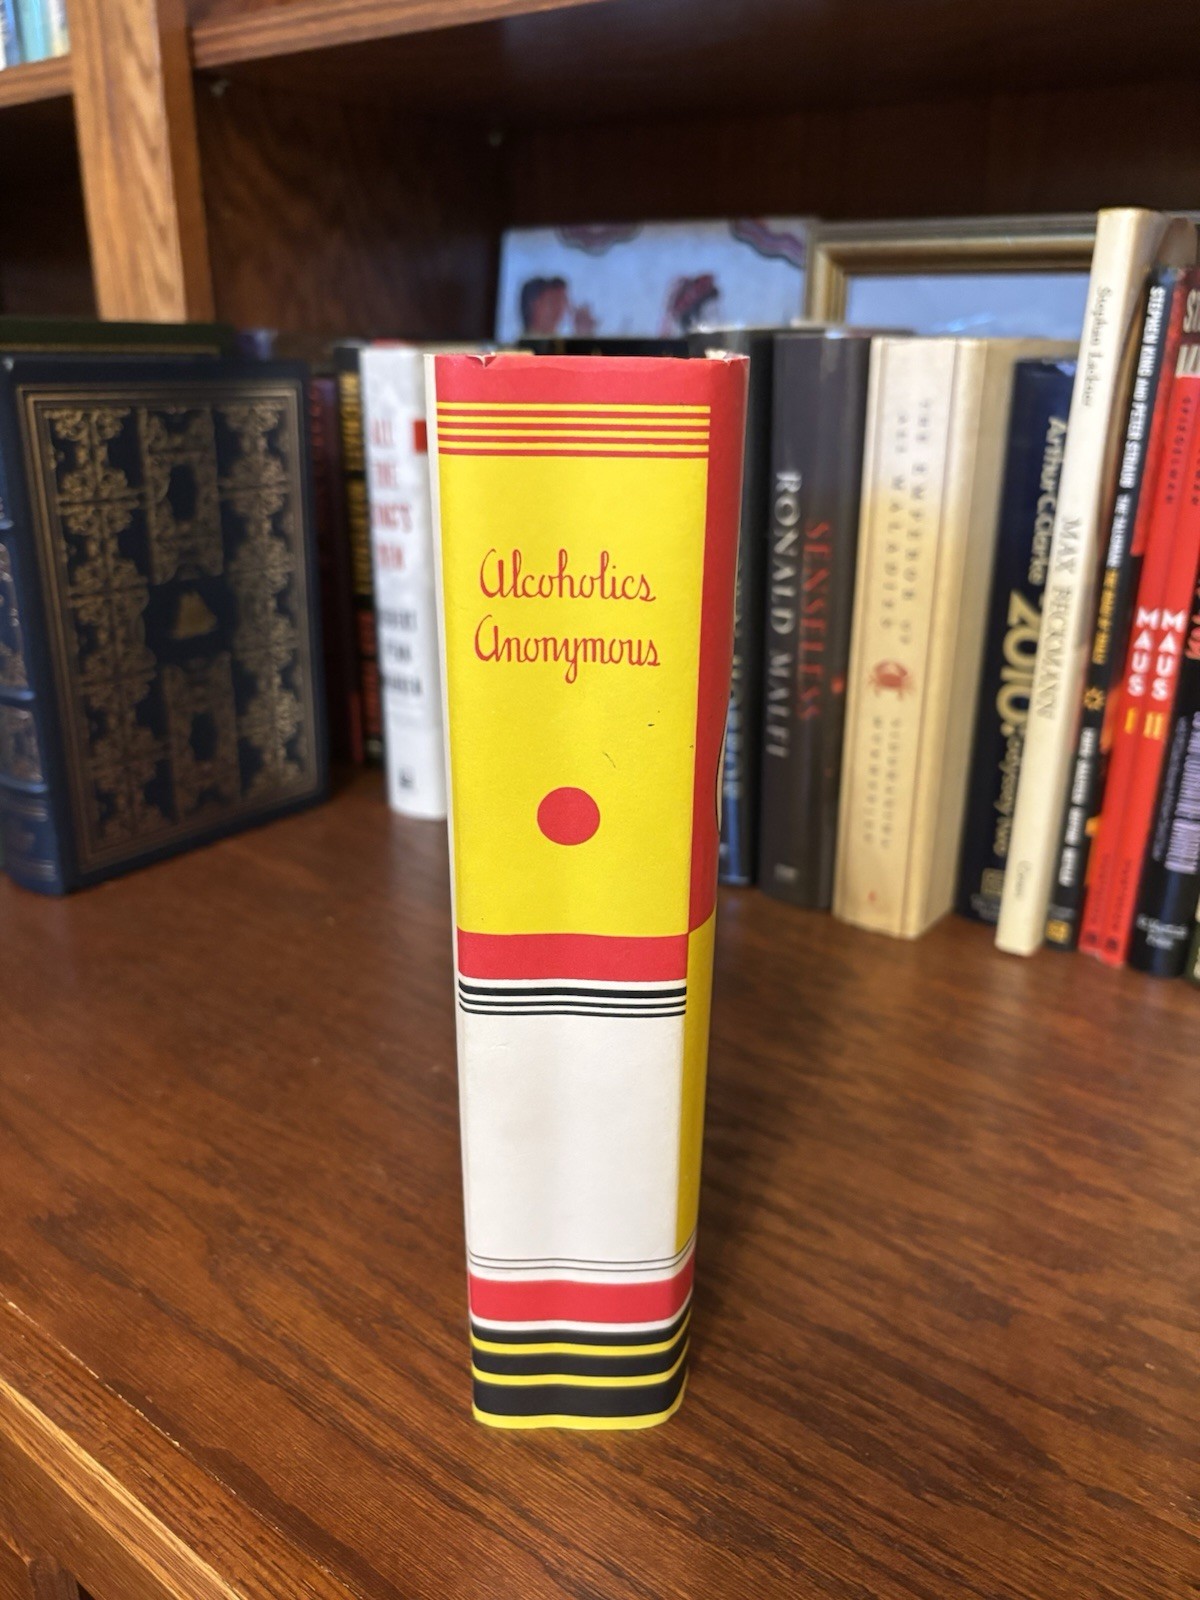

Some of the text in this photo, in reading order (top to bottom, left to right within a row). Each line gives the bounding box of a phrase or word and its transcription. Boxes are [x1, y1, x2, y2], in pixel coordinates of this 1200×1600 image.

[1145, 286, 1166, 344] STEPHEN
[1139, 344, 1157, 377] KING
[1042, 415, 1068, 492] Arthur
[1129, 402, 1148, 441] PETER
[1121, 440, 1142, 489] STRAUB
[479, 548, 657, 603] Alcoholics
[1057, 515, 1081, 575] MAX
[767, 470, 802, 759] RONALD MALFI
[801, 521, 831, 719] SENSELESS
[474, 614, 661, 684] Anonymous
[1129, 606, 1161, 697] MAUS
[1153, 608, 1187, 701] MAUS
